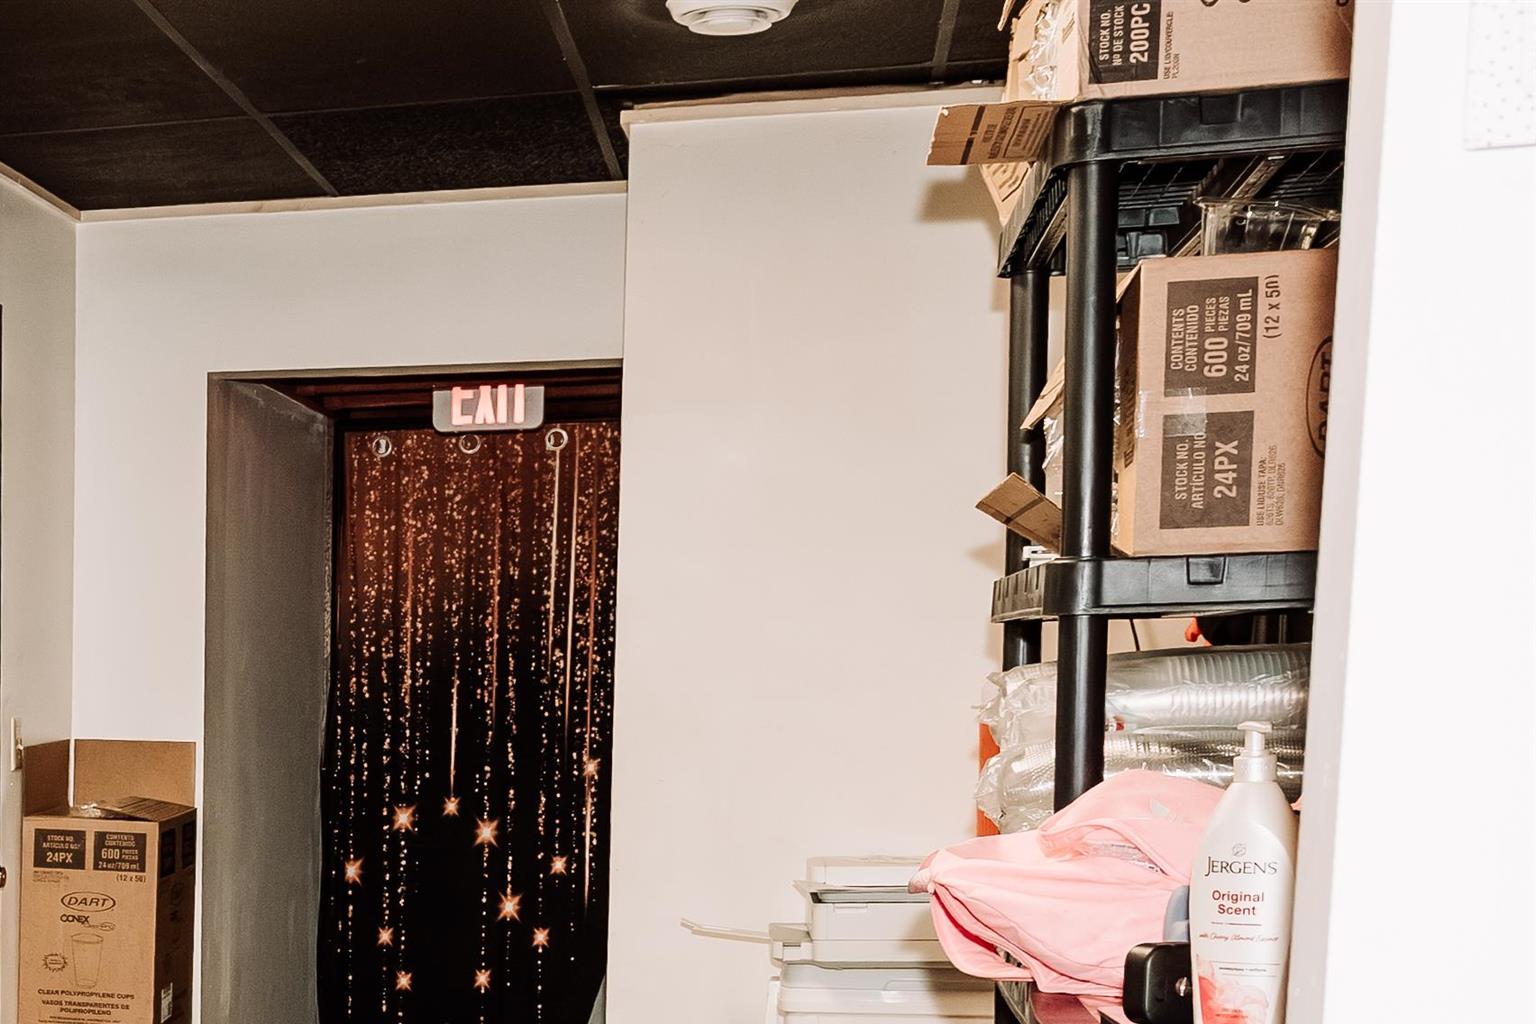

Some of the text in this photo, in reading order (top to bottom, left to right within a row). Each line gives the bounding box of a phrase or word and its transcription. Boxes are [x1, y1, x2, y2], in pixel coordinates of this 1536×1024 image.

[1113, 5, 1125, 37] STOCK
[1129, 3, 1151, 64] 200PC
[1099, 9, 1112, 61] STOCK NO.
[1113, 38, 1124, 52] DE
[1205, 297, 1216, 333] PIECES
[1218, 295, 1230, 331] PIEZAS
[1271, 301, 1281, 310] x
[1170, 308, 1185, 371] CONTENTS
[1184, 304, 1199, 372] CONTENIDO
[1234, 289, 1253, 382] 24 oz/709 mL
[1263, 314, 1282, 340] (12
[1204, 337, 1228, 378] 600
[1175, 438, 1189, 501] STOCK NO.
[1213, 439, 1239, 498] 24PX
[1189, 458, 1204, 509] ARTÍCULO
[46, 852, 73, 864] 24PX
[98, 861, 107, 869] 24
[101, 848, 120, 860] 600
[1205, 856, 1278, 877] JERGENS
[67, 896, 109, 908] DART
[1212, 890, 1265, 904] Original
[1218, 904, 1256, 916] Scent
[60, 914, 90, 925] CONEX
[38, 988, 135, 1000] CLEAR POLYPROPYLENE CUPS
[64, 1001, 119, 1010] TRANSPARENTES
